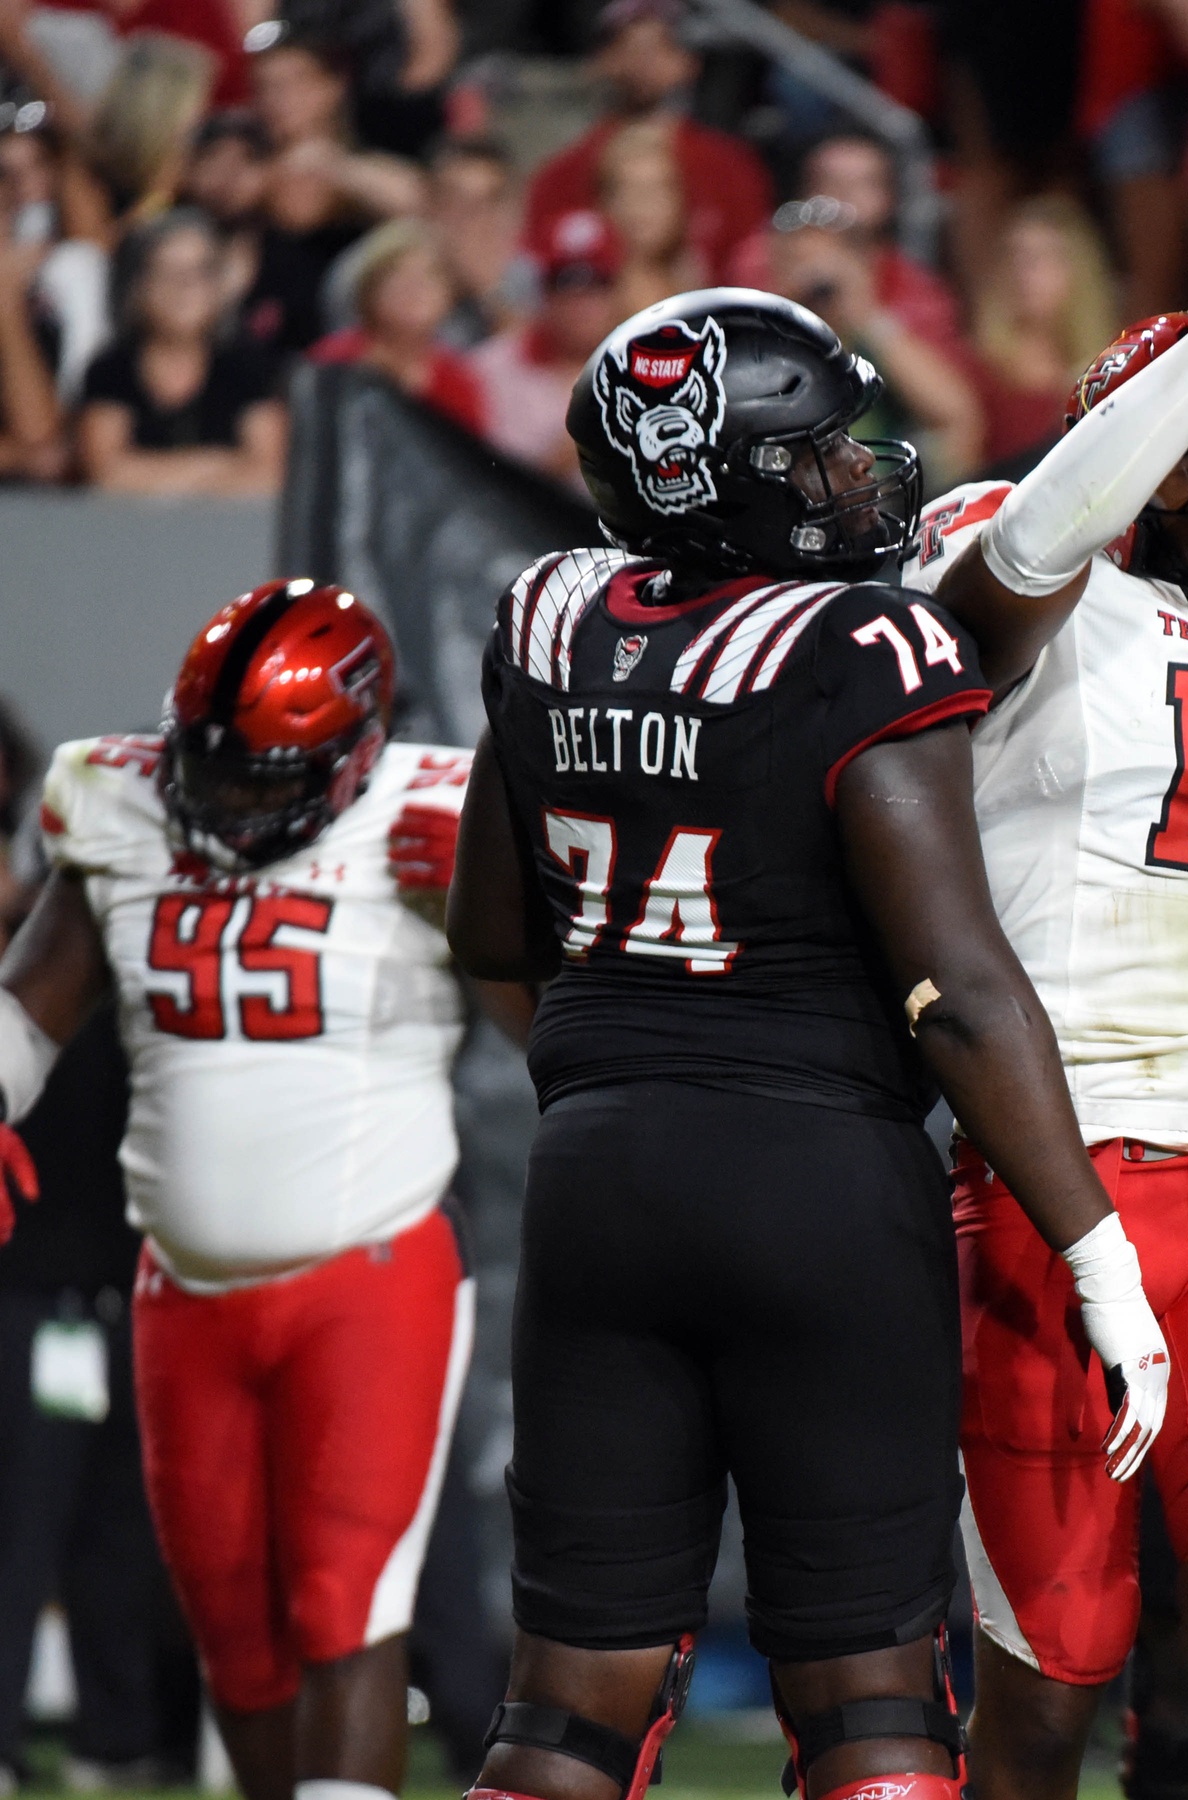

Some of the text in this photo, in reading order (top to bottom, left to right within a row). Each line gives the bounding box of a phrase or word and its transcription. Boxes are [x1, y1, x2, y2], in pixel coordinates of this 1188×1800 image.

[634, 355, 686, 378] NC STATE
[850, 602, 965, 696] 74
[548, 707, 702, 781] BELTON
[542, 804, 746, 976] 74
[146, 892, 336, 1040] 95
